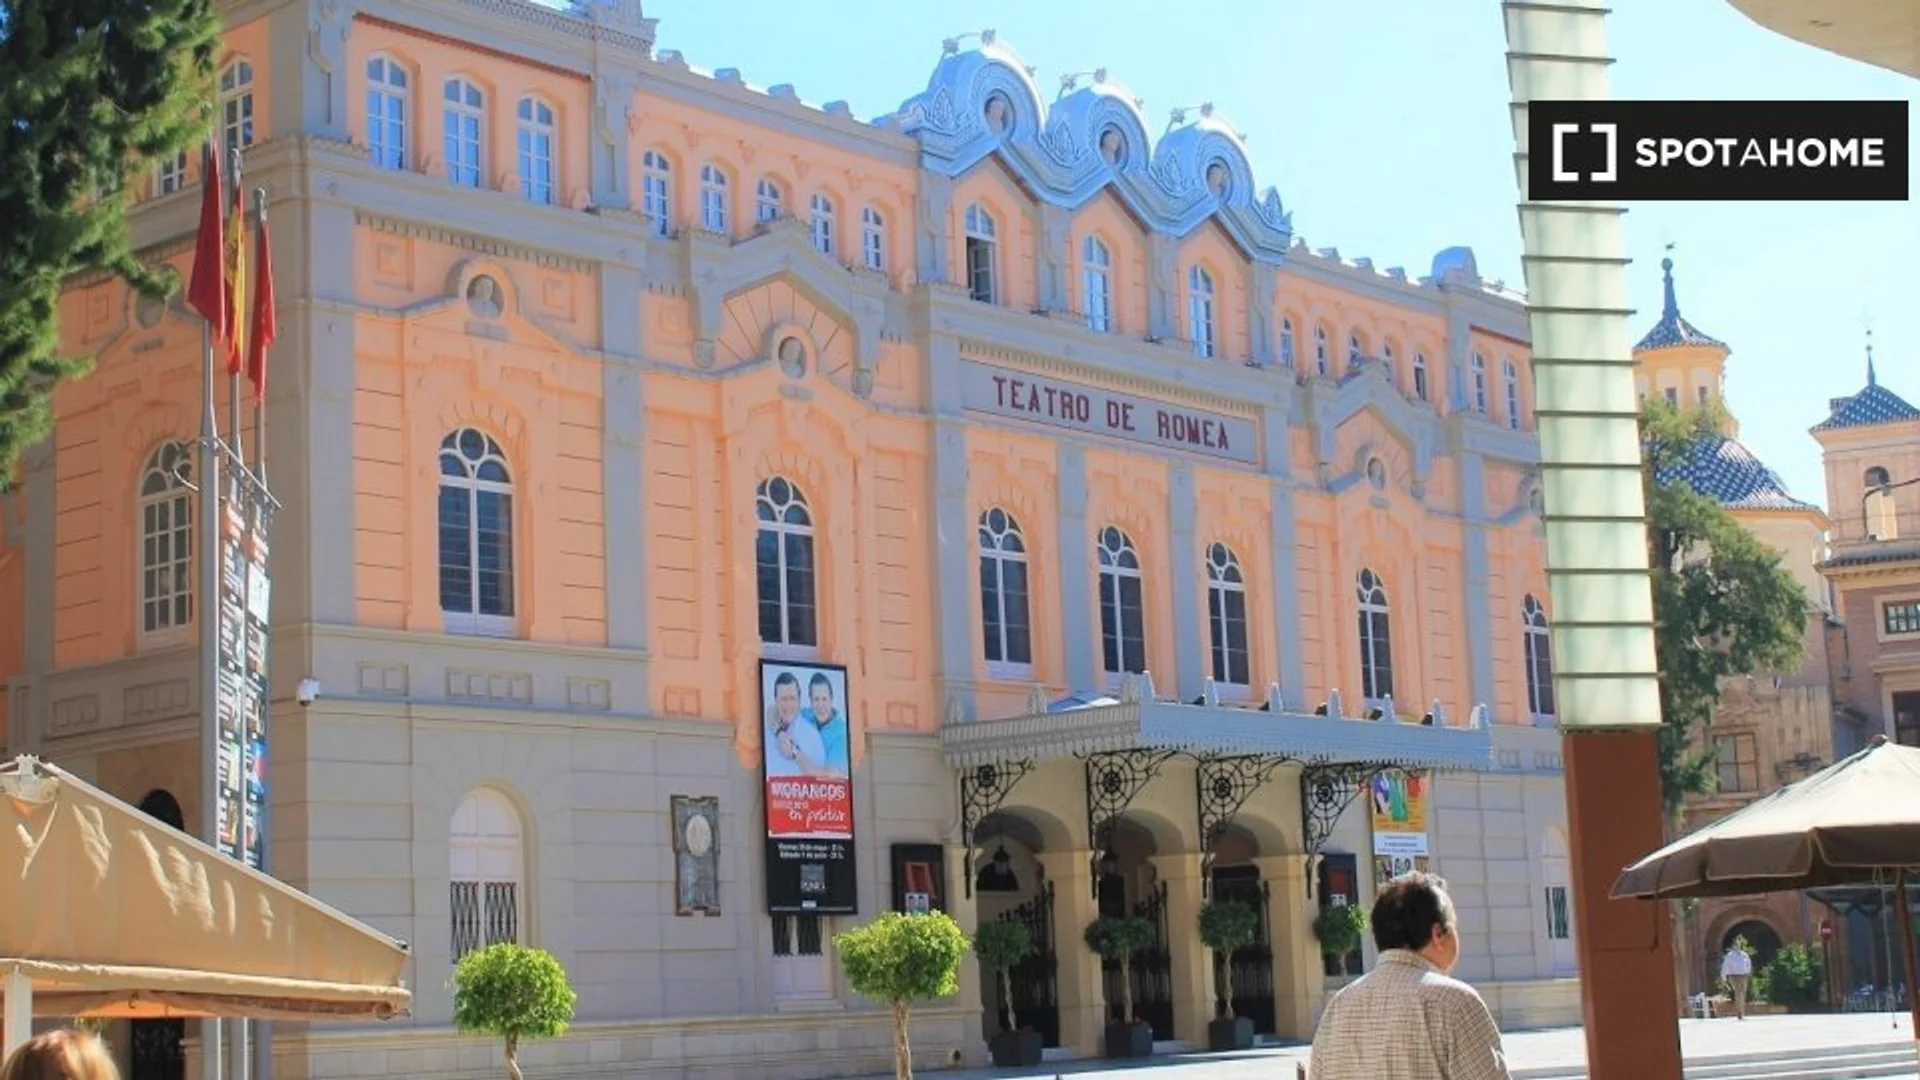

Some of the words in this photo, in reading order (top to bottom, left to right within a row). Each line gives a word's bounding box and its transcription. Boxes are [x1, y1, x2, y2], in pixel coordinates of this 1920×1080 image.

[993, 376, 1090, 423] TEATRO
[1106, 400, 1135, 432] DE
[1157, 410, 1230, 450] ROMEA
[771, 781, 846, 801] MORANCOS
